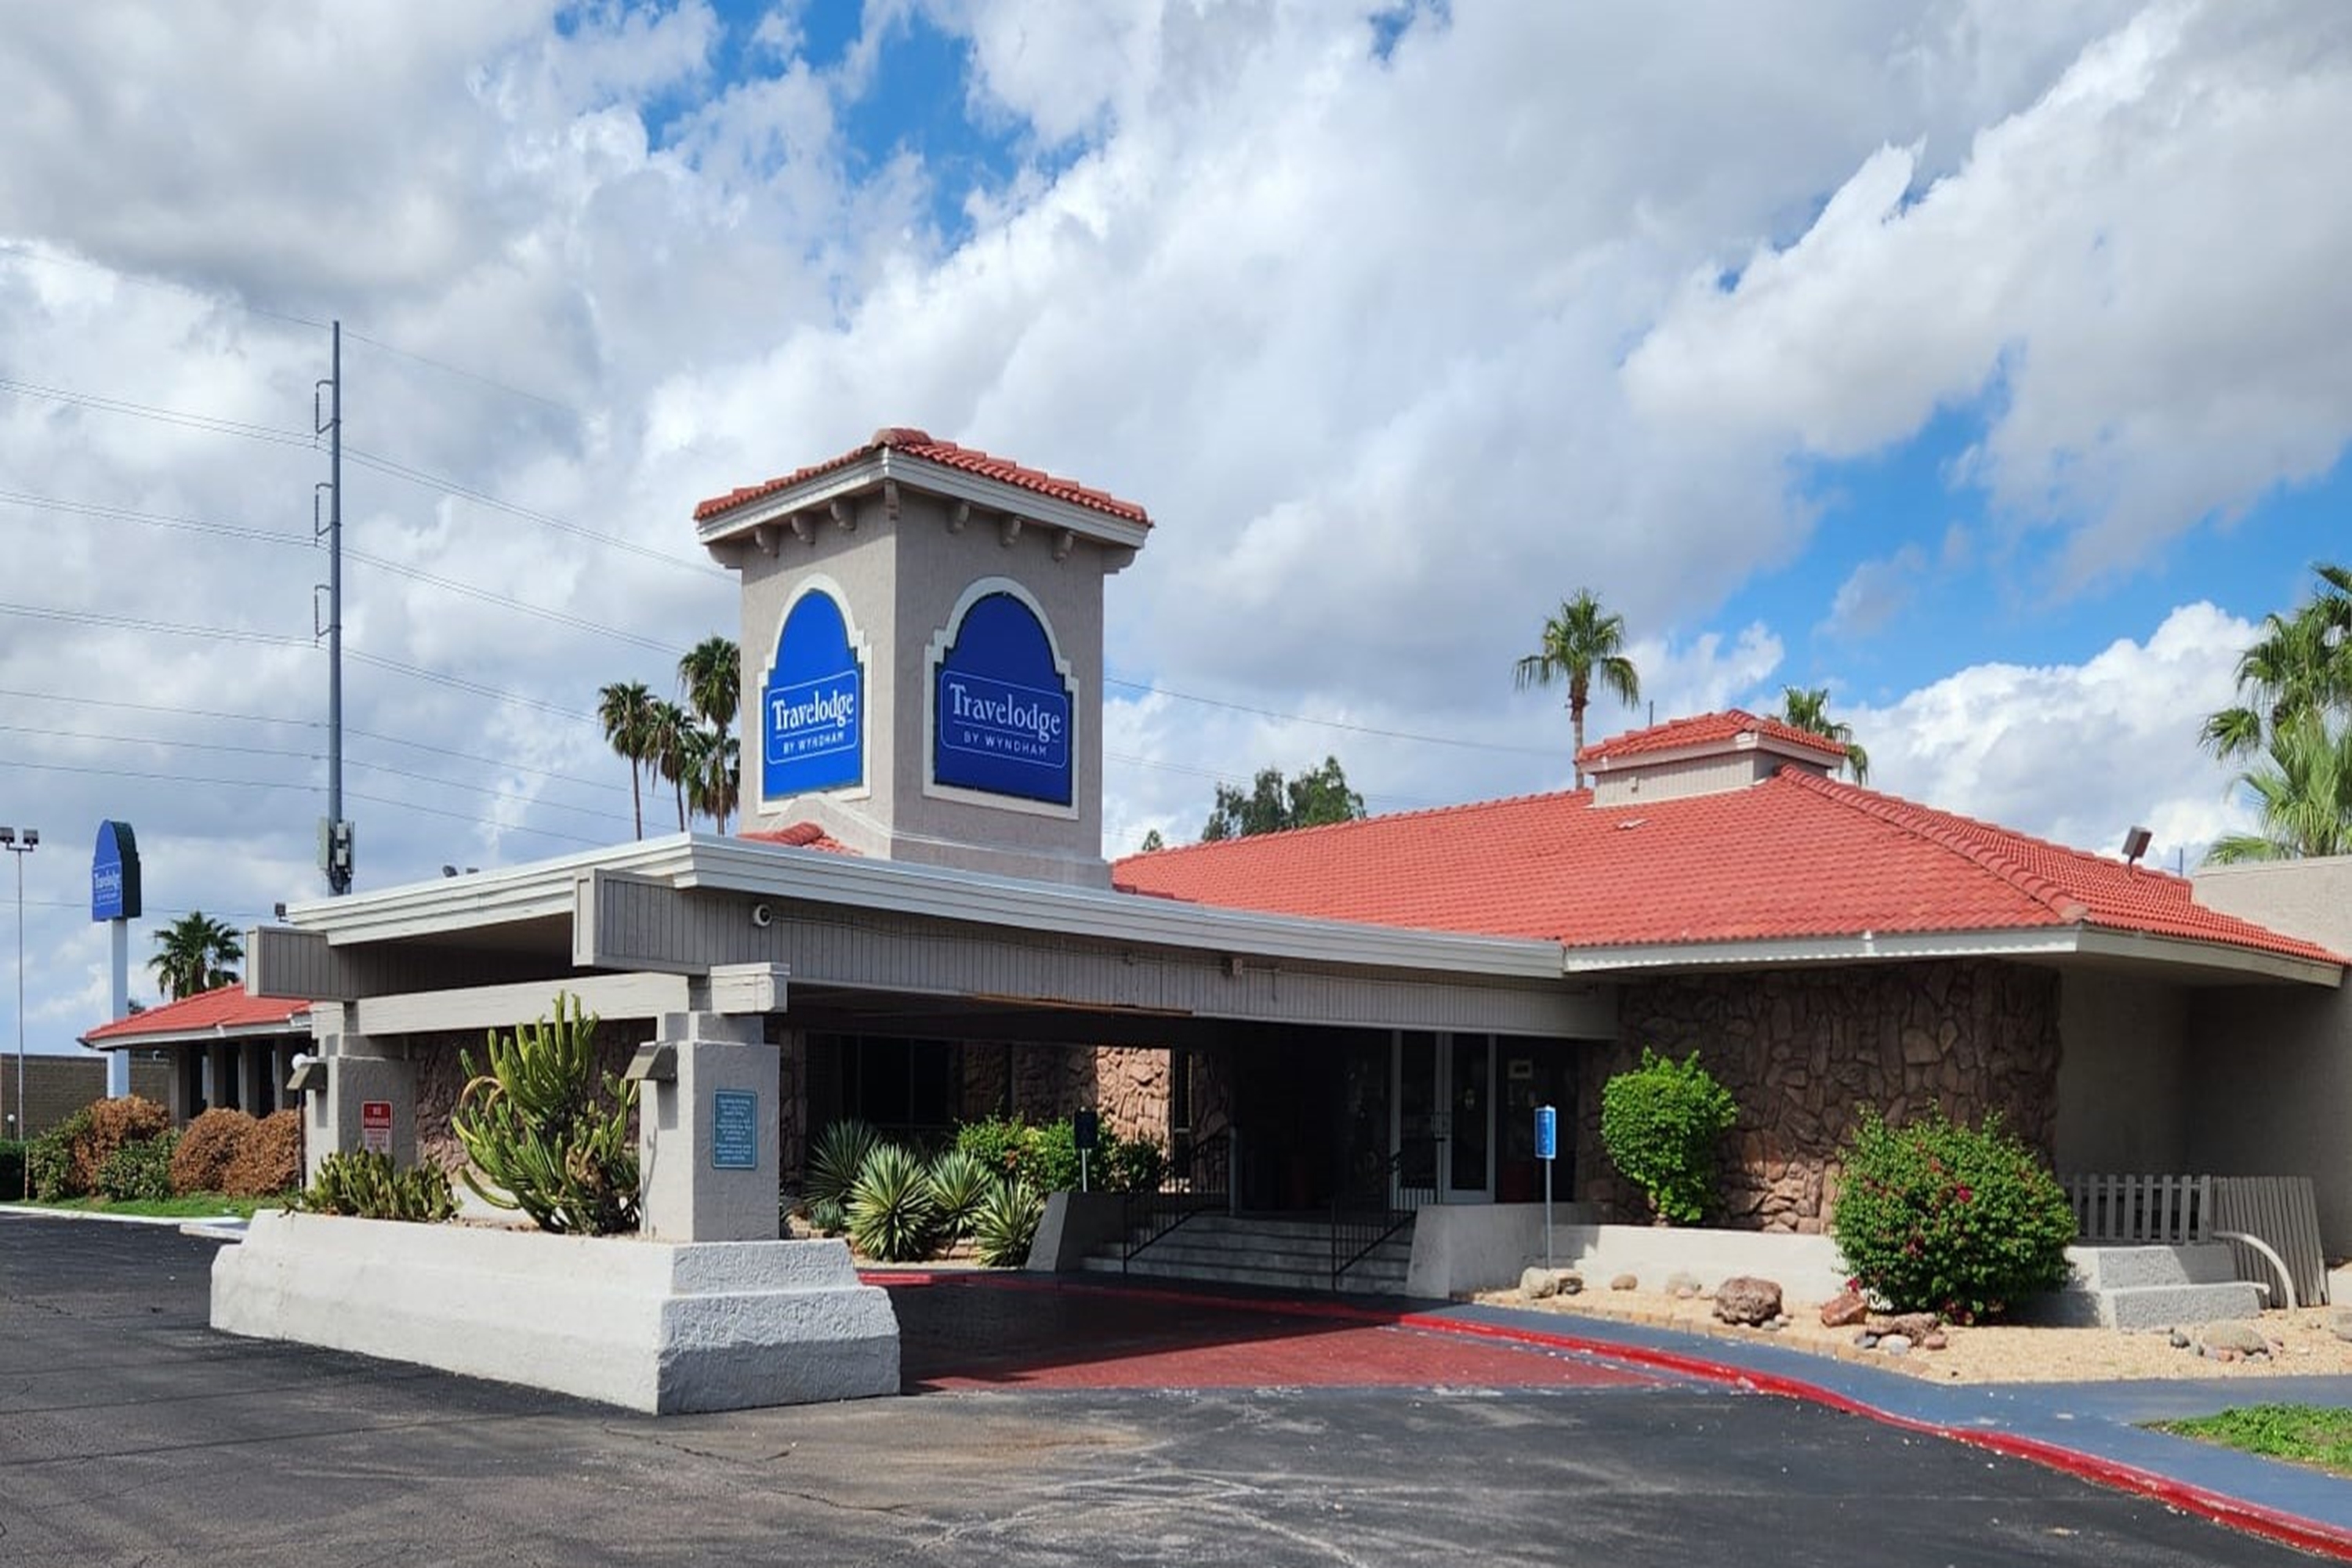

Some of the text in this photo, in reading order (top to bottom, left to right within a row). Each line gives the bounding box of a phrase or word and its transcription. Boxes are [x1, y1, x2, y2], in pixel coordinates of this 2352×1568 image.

[771, 689, 854, 731] Travelodge
[949, 683, 1061, 742] Travelodge
[783, 742, 794, 754] BY
[964, 731, 1047, 757] BY WYNDHAM
